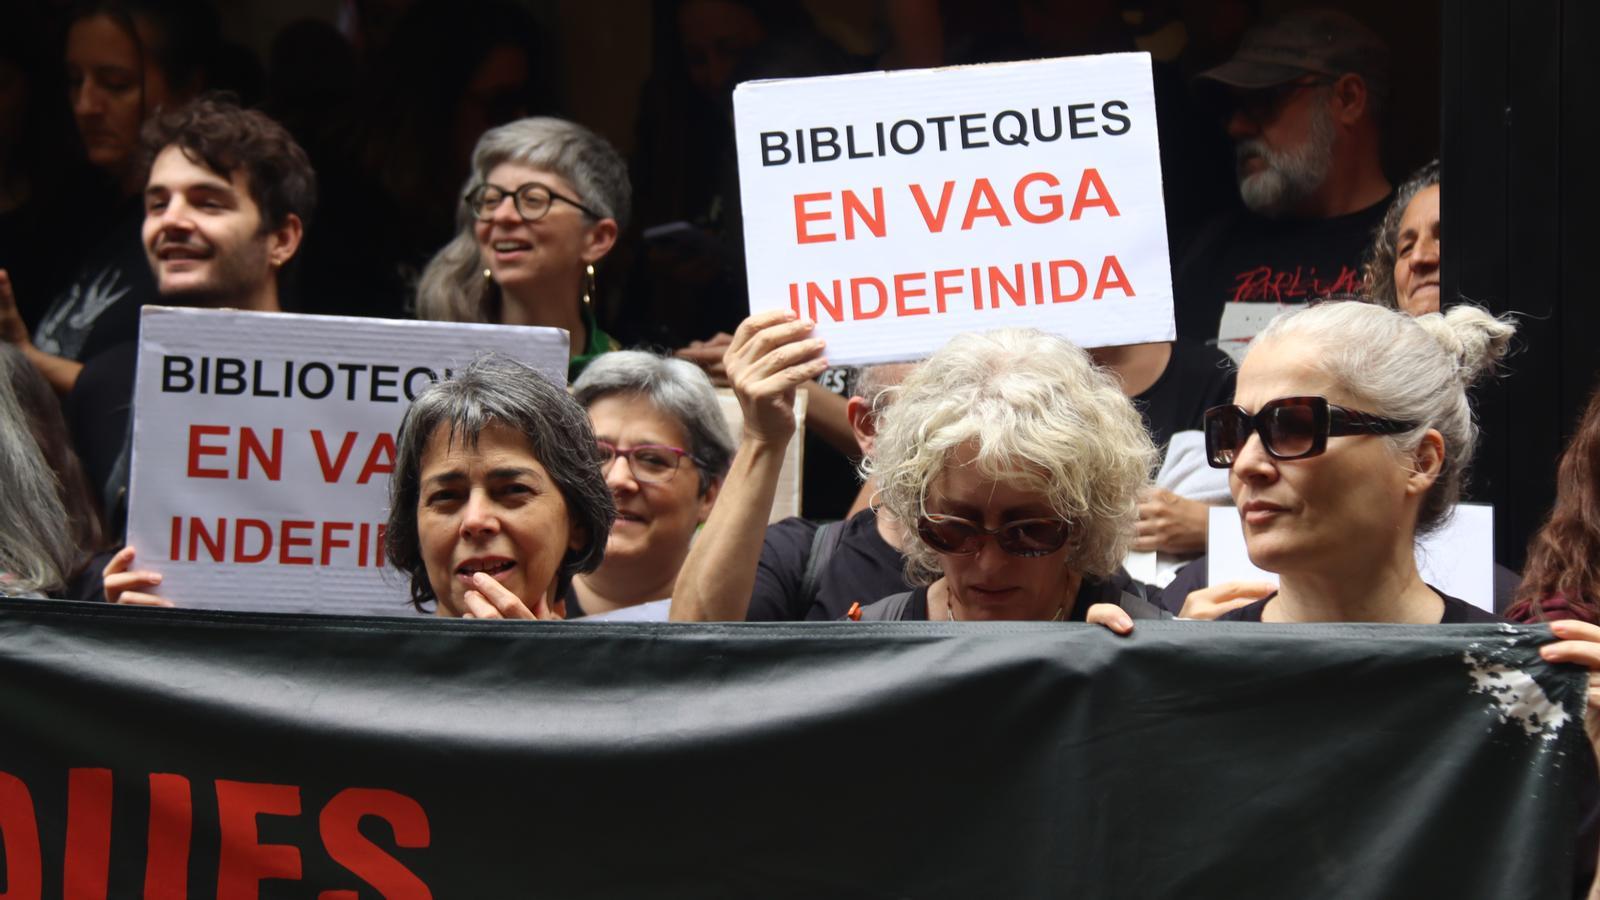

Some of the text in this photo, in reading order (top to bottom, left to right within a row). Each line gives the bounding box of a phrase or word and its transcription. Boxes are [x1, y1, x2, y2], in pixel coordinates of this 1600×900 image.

[760, 100, 1132, 167] BIBLIOTEQUES
[793, 168, 1121, 245] EN VAGA
[788, 255, 1136, 324] INDEFINIDA
[187, 425, 397, 484] EN VA
[170, 516, 387, 568] INDEFI
